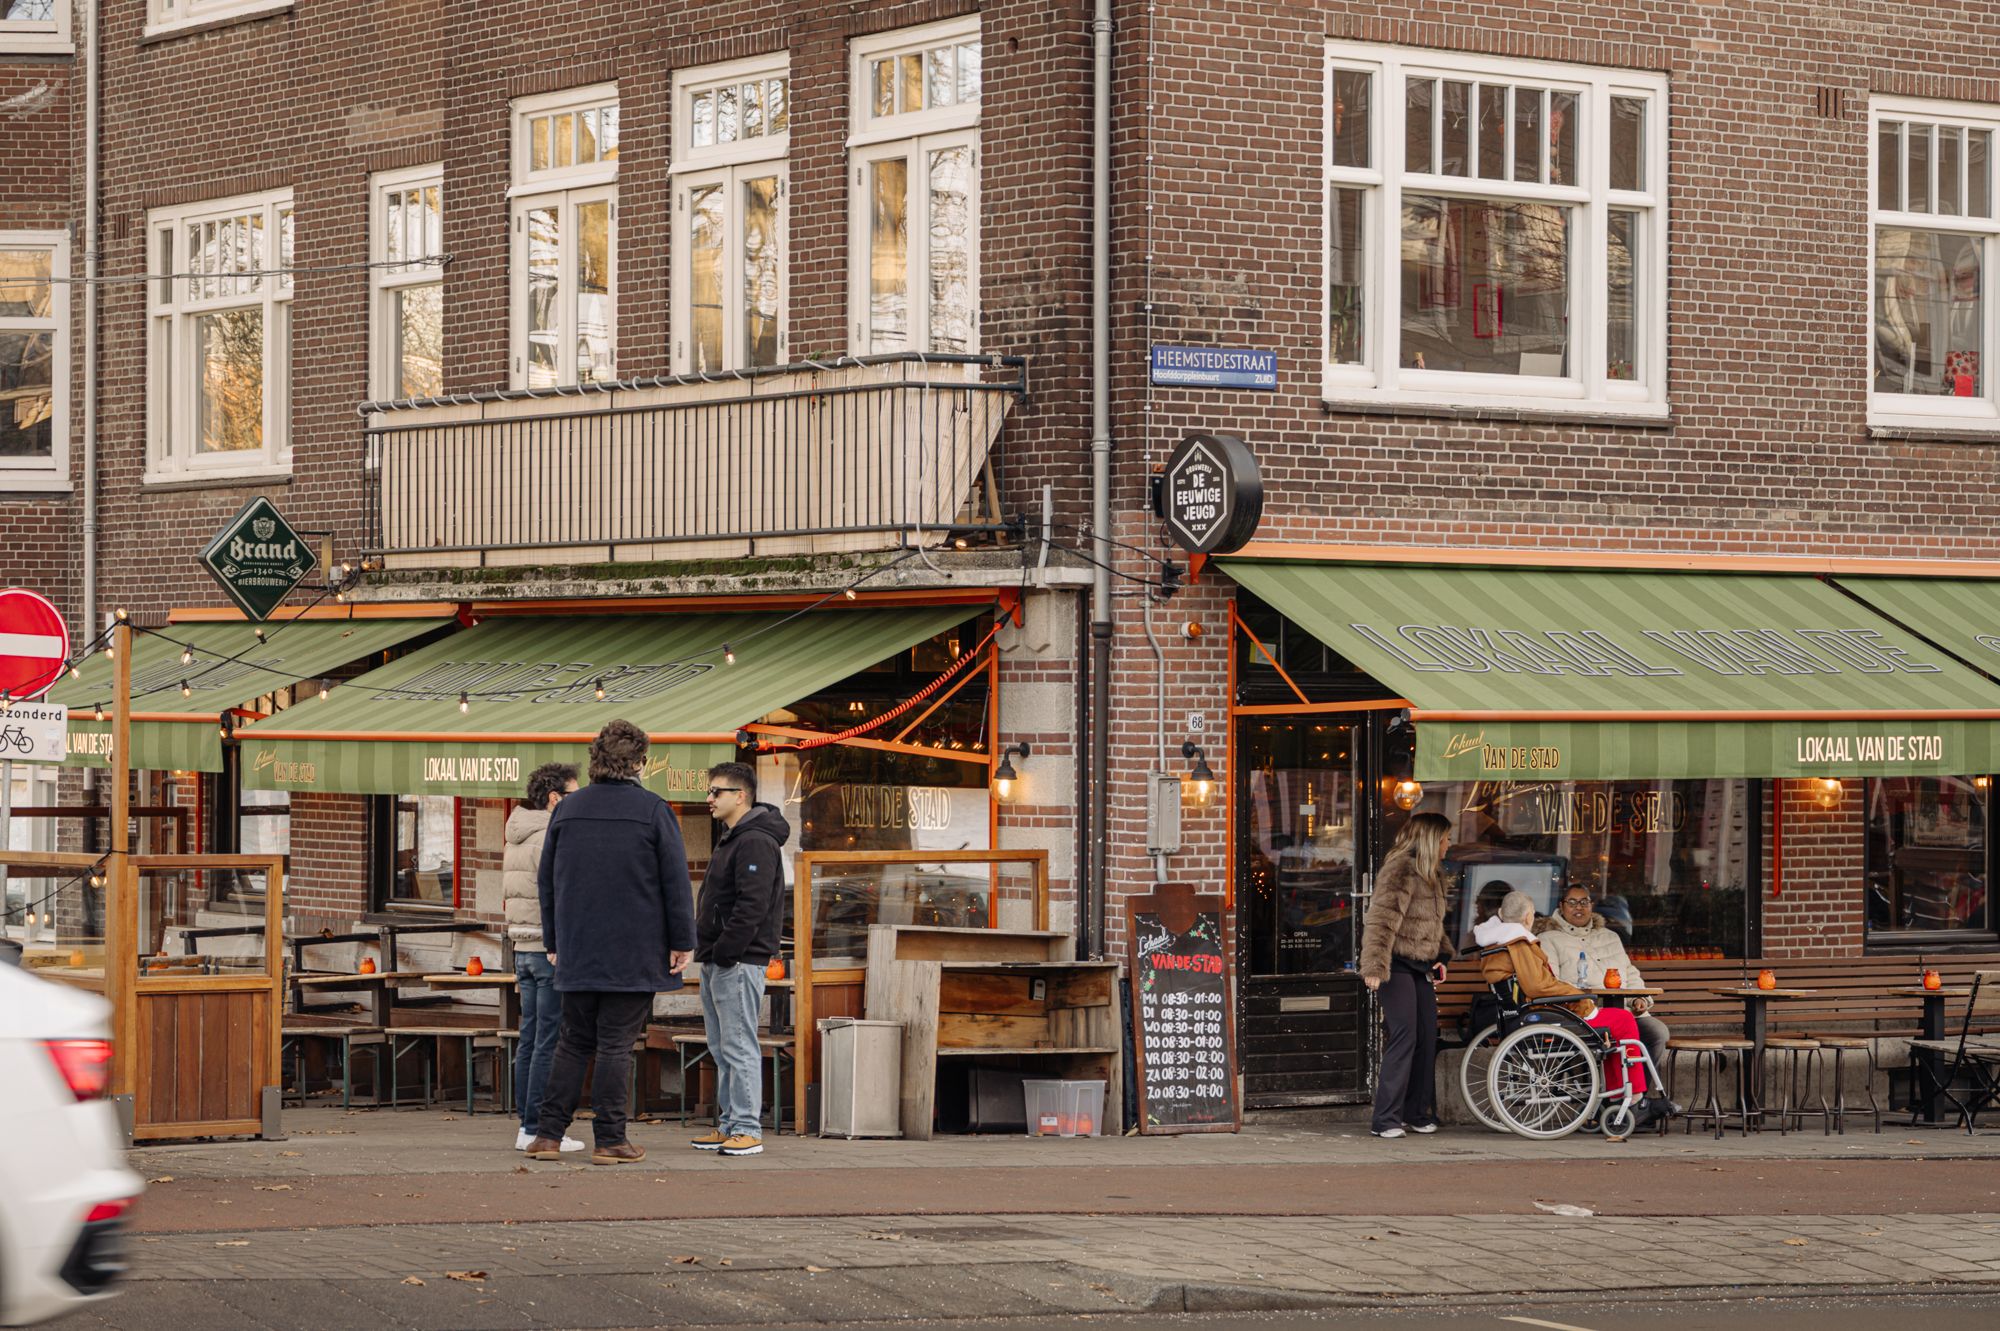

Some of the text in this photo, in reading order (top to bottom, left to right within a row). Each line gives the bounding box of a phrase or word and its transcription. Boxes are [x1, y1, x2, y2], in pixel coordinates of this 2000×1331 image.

[1157, 350, 1273, 371] HEEMSTEDESTRAAT
[1153, 369, 1273, 384] Hoofddorppleinbuurt ZUID
[1185, 463, 1212, 475] BROUWERIJ
[1193, 473, 1205, 488] DE
[1176, 487, 1221, 506] EEUWIGE
[1183, 505, 1216, 520] JEUGD
[230, 535, 297, 560] Brand
[253, 567, 273, 576] 1340
[238, 577, 288, 587] BIERBROUWERIJ
[1349, 623, 1685, 677] LOKAAL
[1642, 629, 1840, 676] VAN
[1797, 628, 1942, 674] DE
[1192, 716, 1203, 729] 68
[73, 733, 88, 753] VAN
[88, 733, 99, 754] DE
[99, 733, 113, 754] STA
[1440, 729, 1484, 758] Lokaal
[1798, 736, 1942, 762] LOKAAL VAN DE STAD
[1482, 743, 1560, 770] VAN DE STAD
[424, 757, 519, 781] LOKAAL VAN DE STAD
[667, 765, 683, 791] VAN
[685, 768, 696, 791] DE
[841, 785, 951, 830] VAN DE STAD
[1539, 783, 1686, 834] VAN DE STAD
[1151, 953, 1223, 974] VAN DE STAD
[1143, 993, 1158, 1005] MA
[1143, 1006, 1155, 1018] DI
[1144, 1021, 1160, 1032] WO
[1145, 1036, 1160, 1048] DO
[1145, 1052, 1160, 1065] VR
[1146, 1069, 1160, 1082] ZA
